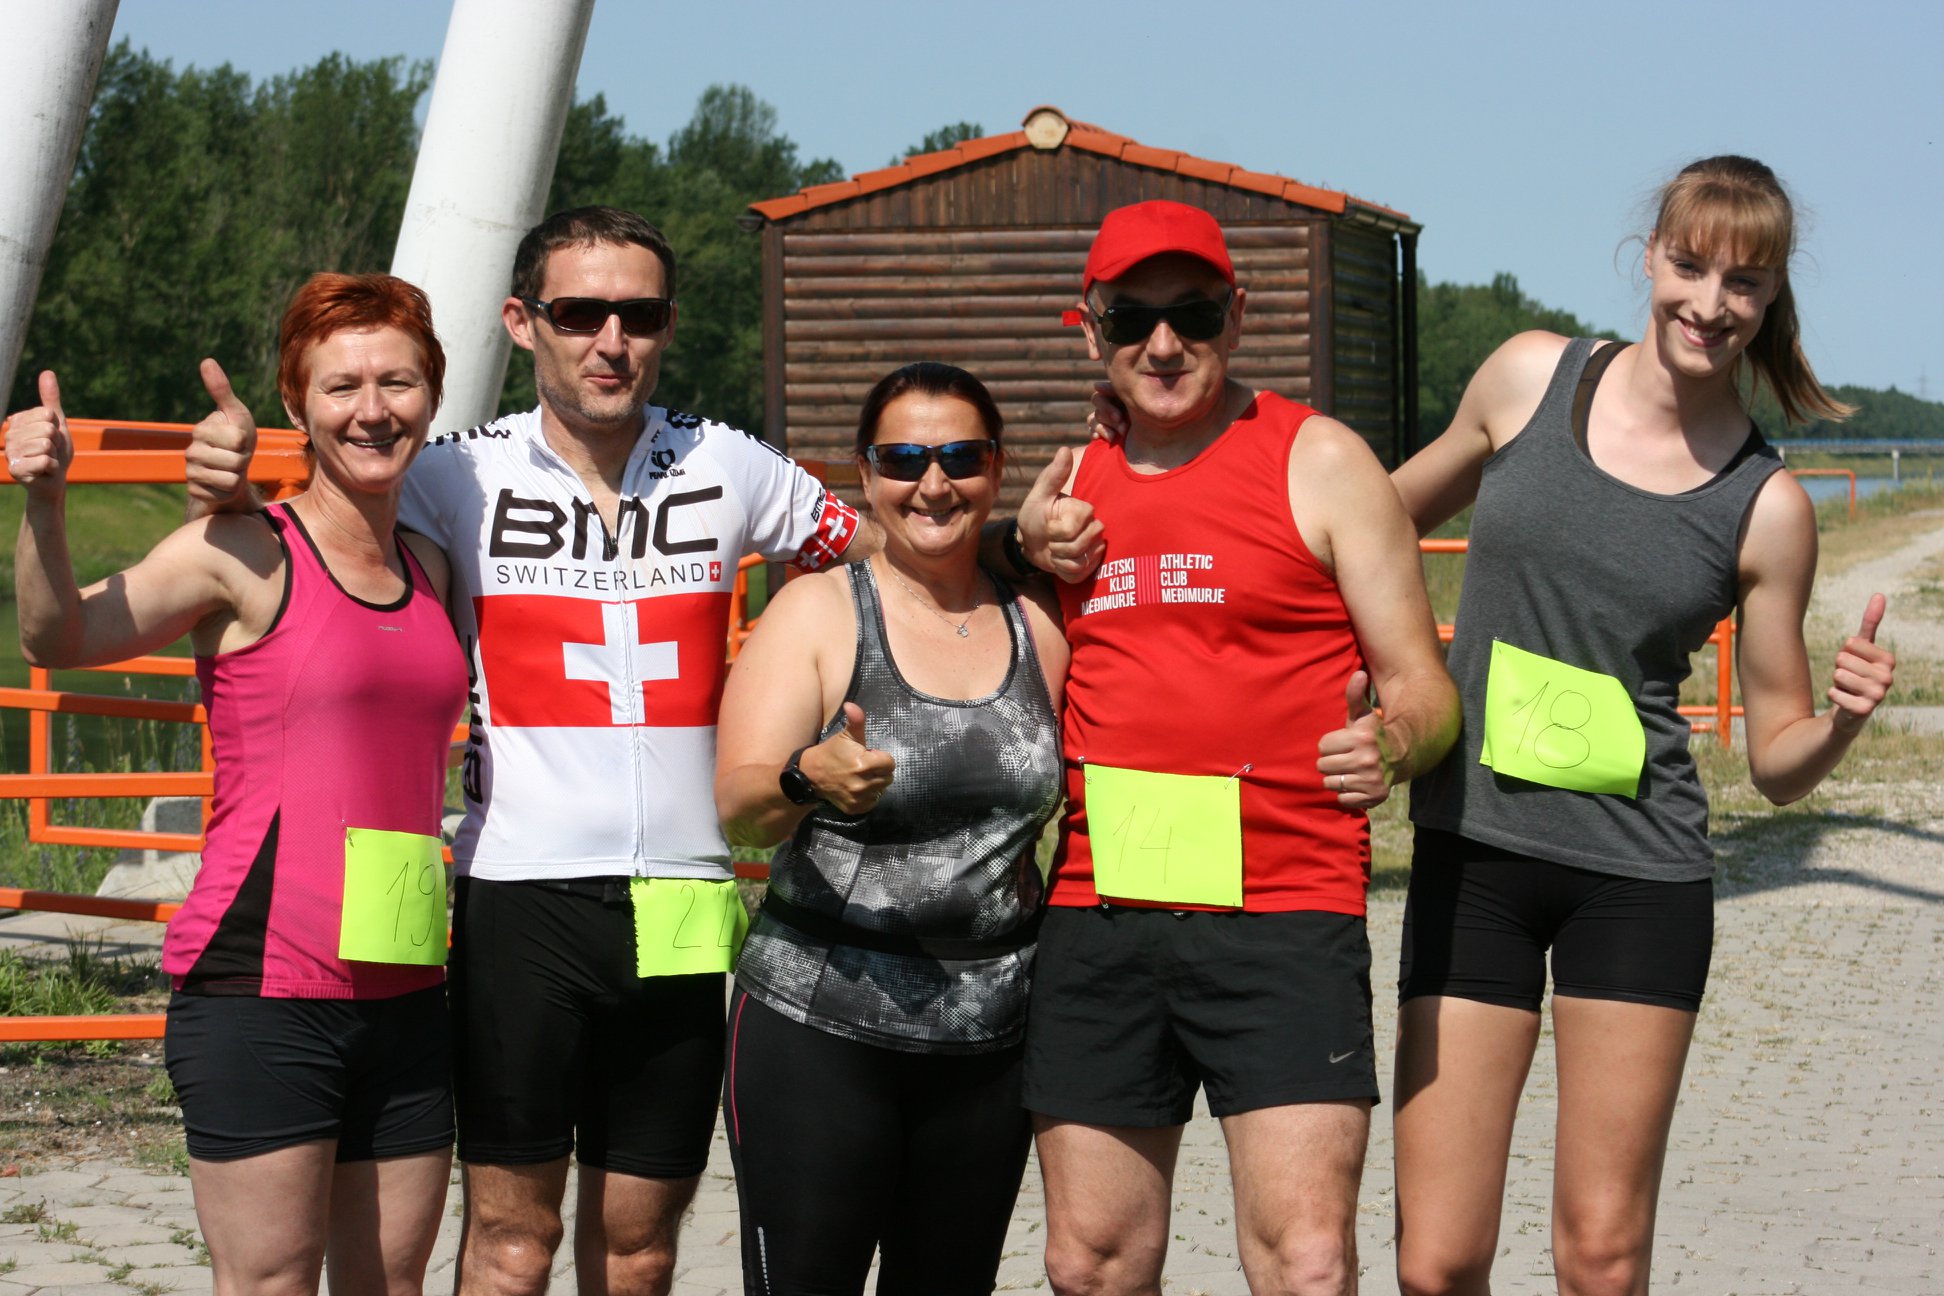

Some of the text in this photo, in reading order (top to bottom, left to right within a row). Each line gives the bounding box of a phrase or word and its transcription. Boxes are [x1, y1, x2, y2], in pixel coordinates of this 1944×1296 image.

[489, 485, 723, 561] BMC
[496, 562, 704, 591] SWITZERLAND
[1109, 574, 1136, 593] KLUB
[1160, 554, 1213, 570] ATHLETIC
[1160, 571, 1188, 587] CLUB
[1512, 681, 1592, 769] 18
[1113, 805, 1172, 885] 14
[386, 861, 437, 947] 19
